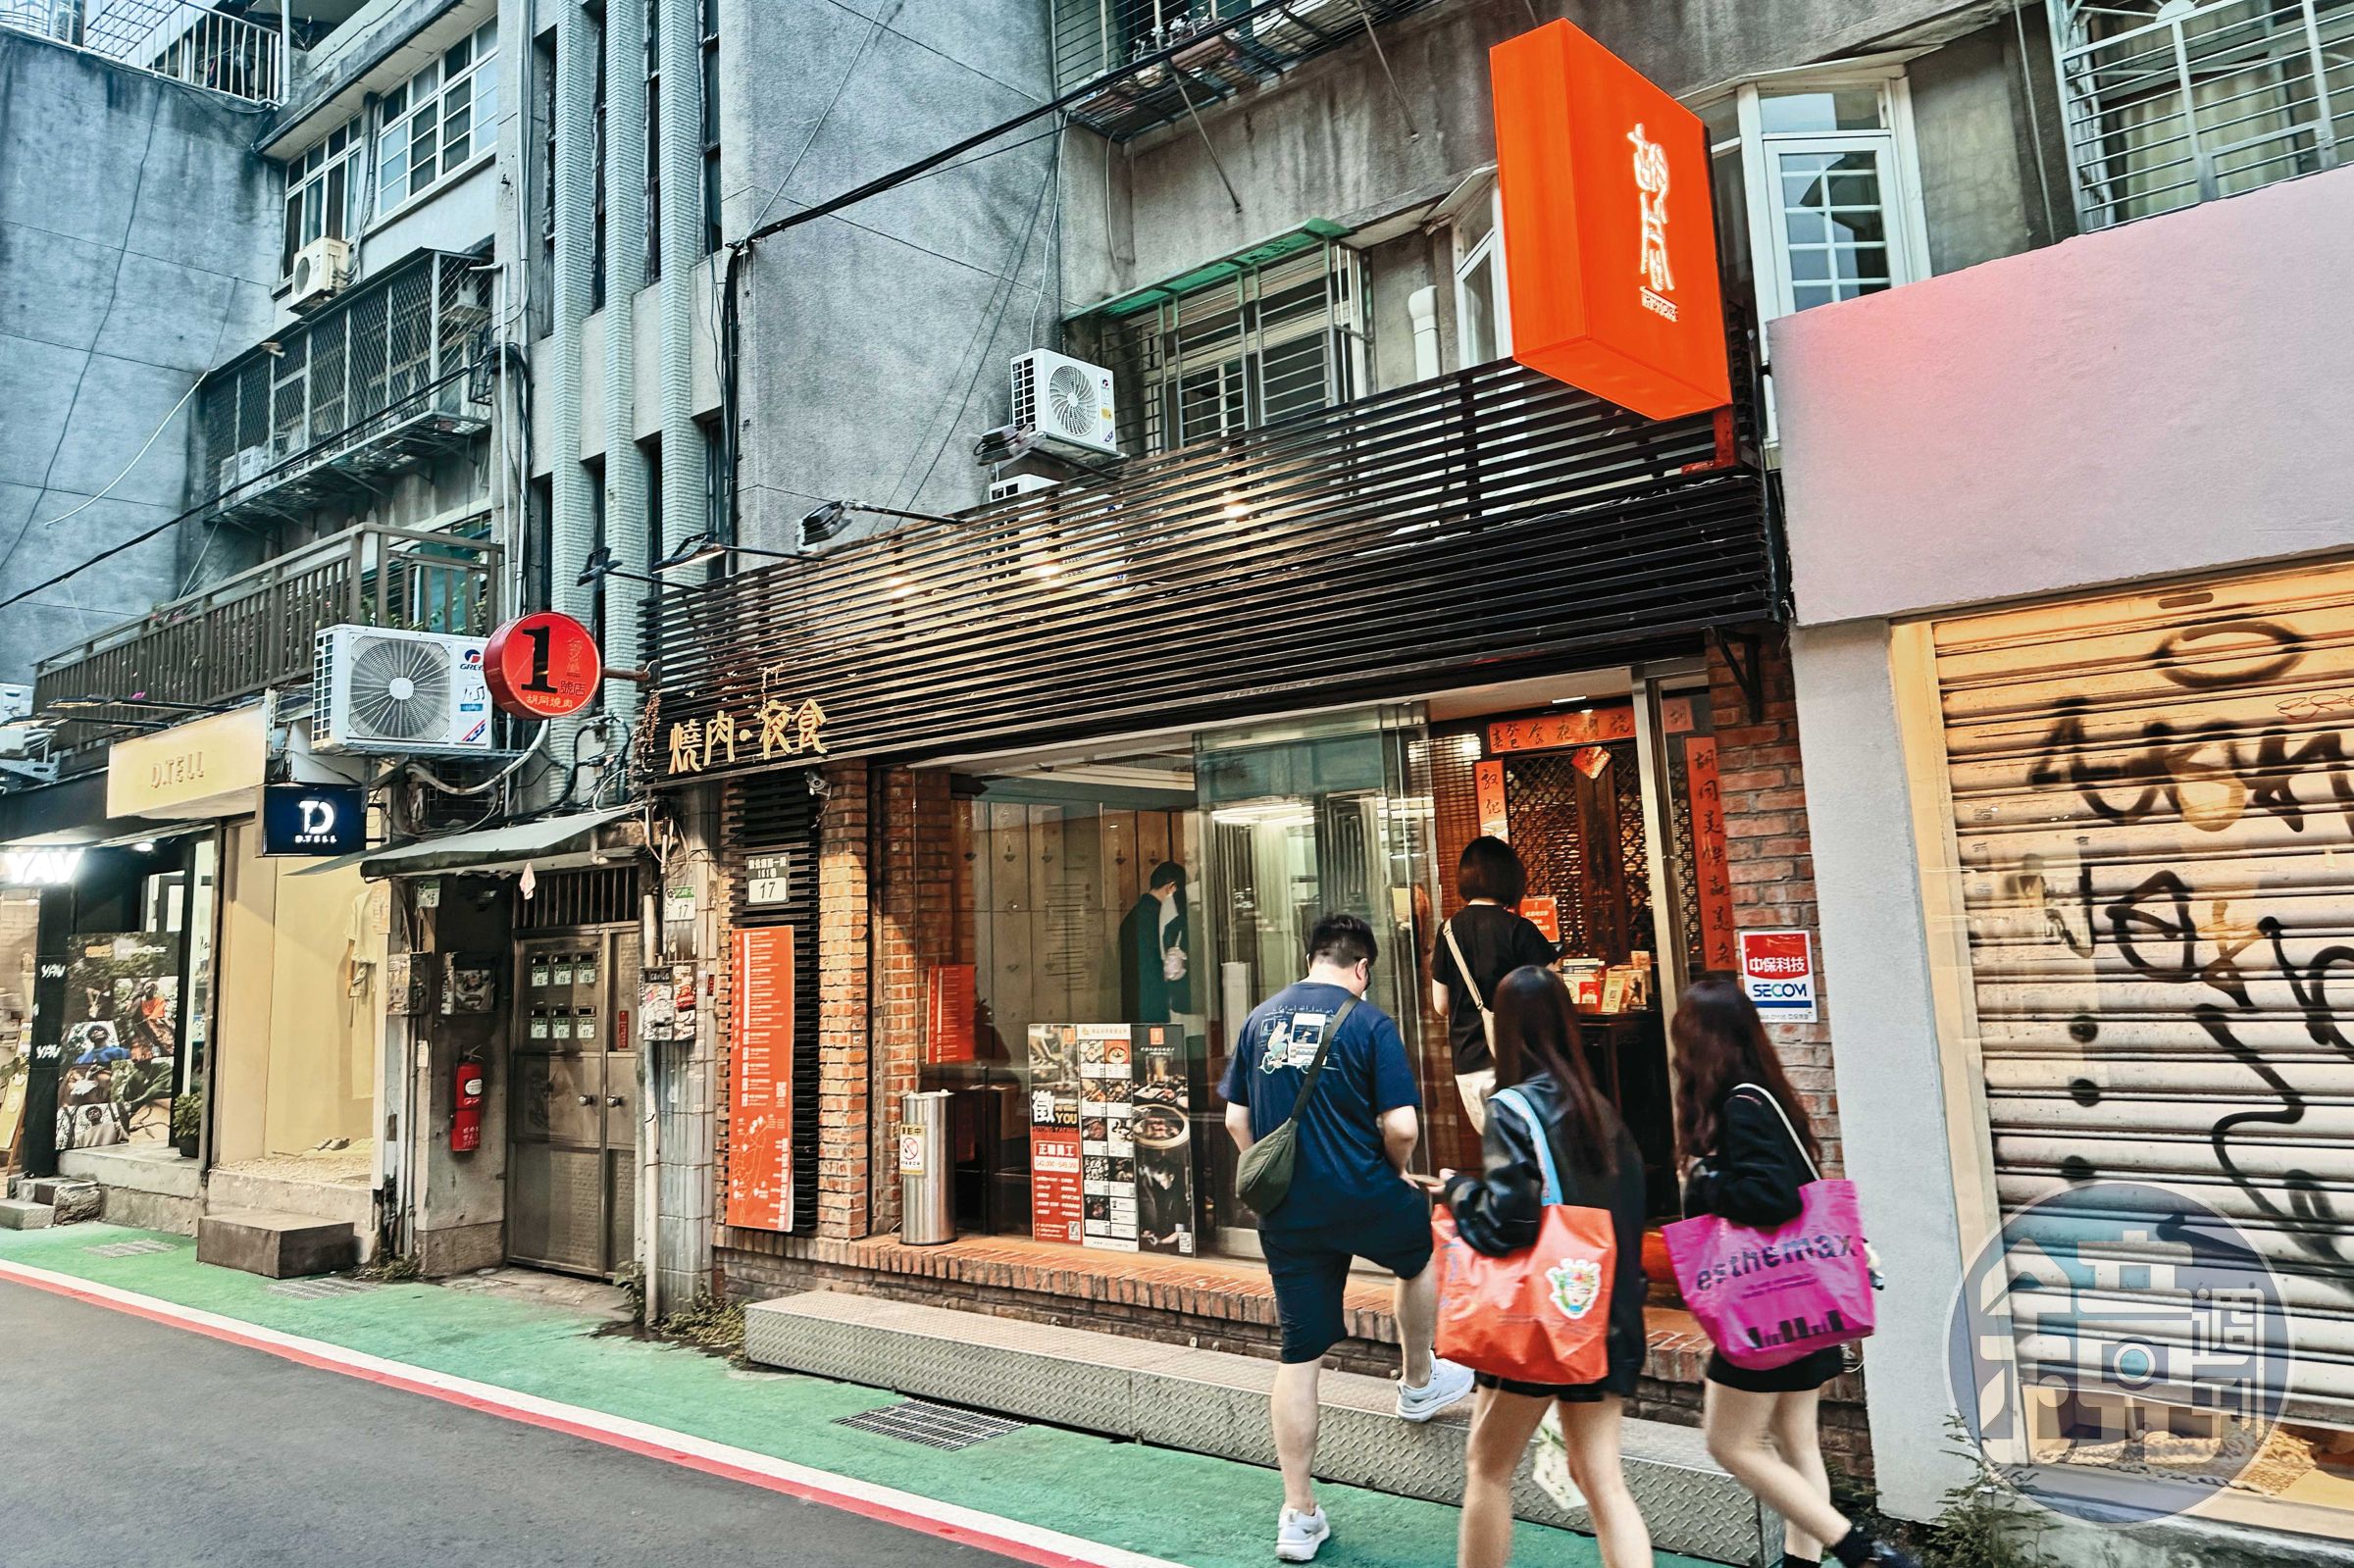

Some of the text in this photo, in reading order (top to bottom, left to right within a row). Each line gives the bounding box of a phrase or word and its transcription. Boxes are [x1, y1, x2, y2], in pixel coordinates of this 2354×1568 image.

[151, 751, 204, 788] D.TELL
[295, 835, 337, 843] D.TELL
[759, 882, 776, 899] 17
[678, 904, 690, 919] 17
[1749, 957, 1806, 973] 中保科技
[1753, 984, 1808, 997] SECOM
[1054, 1113, 1078, 1125] YOU
[1697, 1234, 1859, 1291] esthemax
